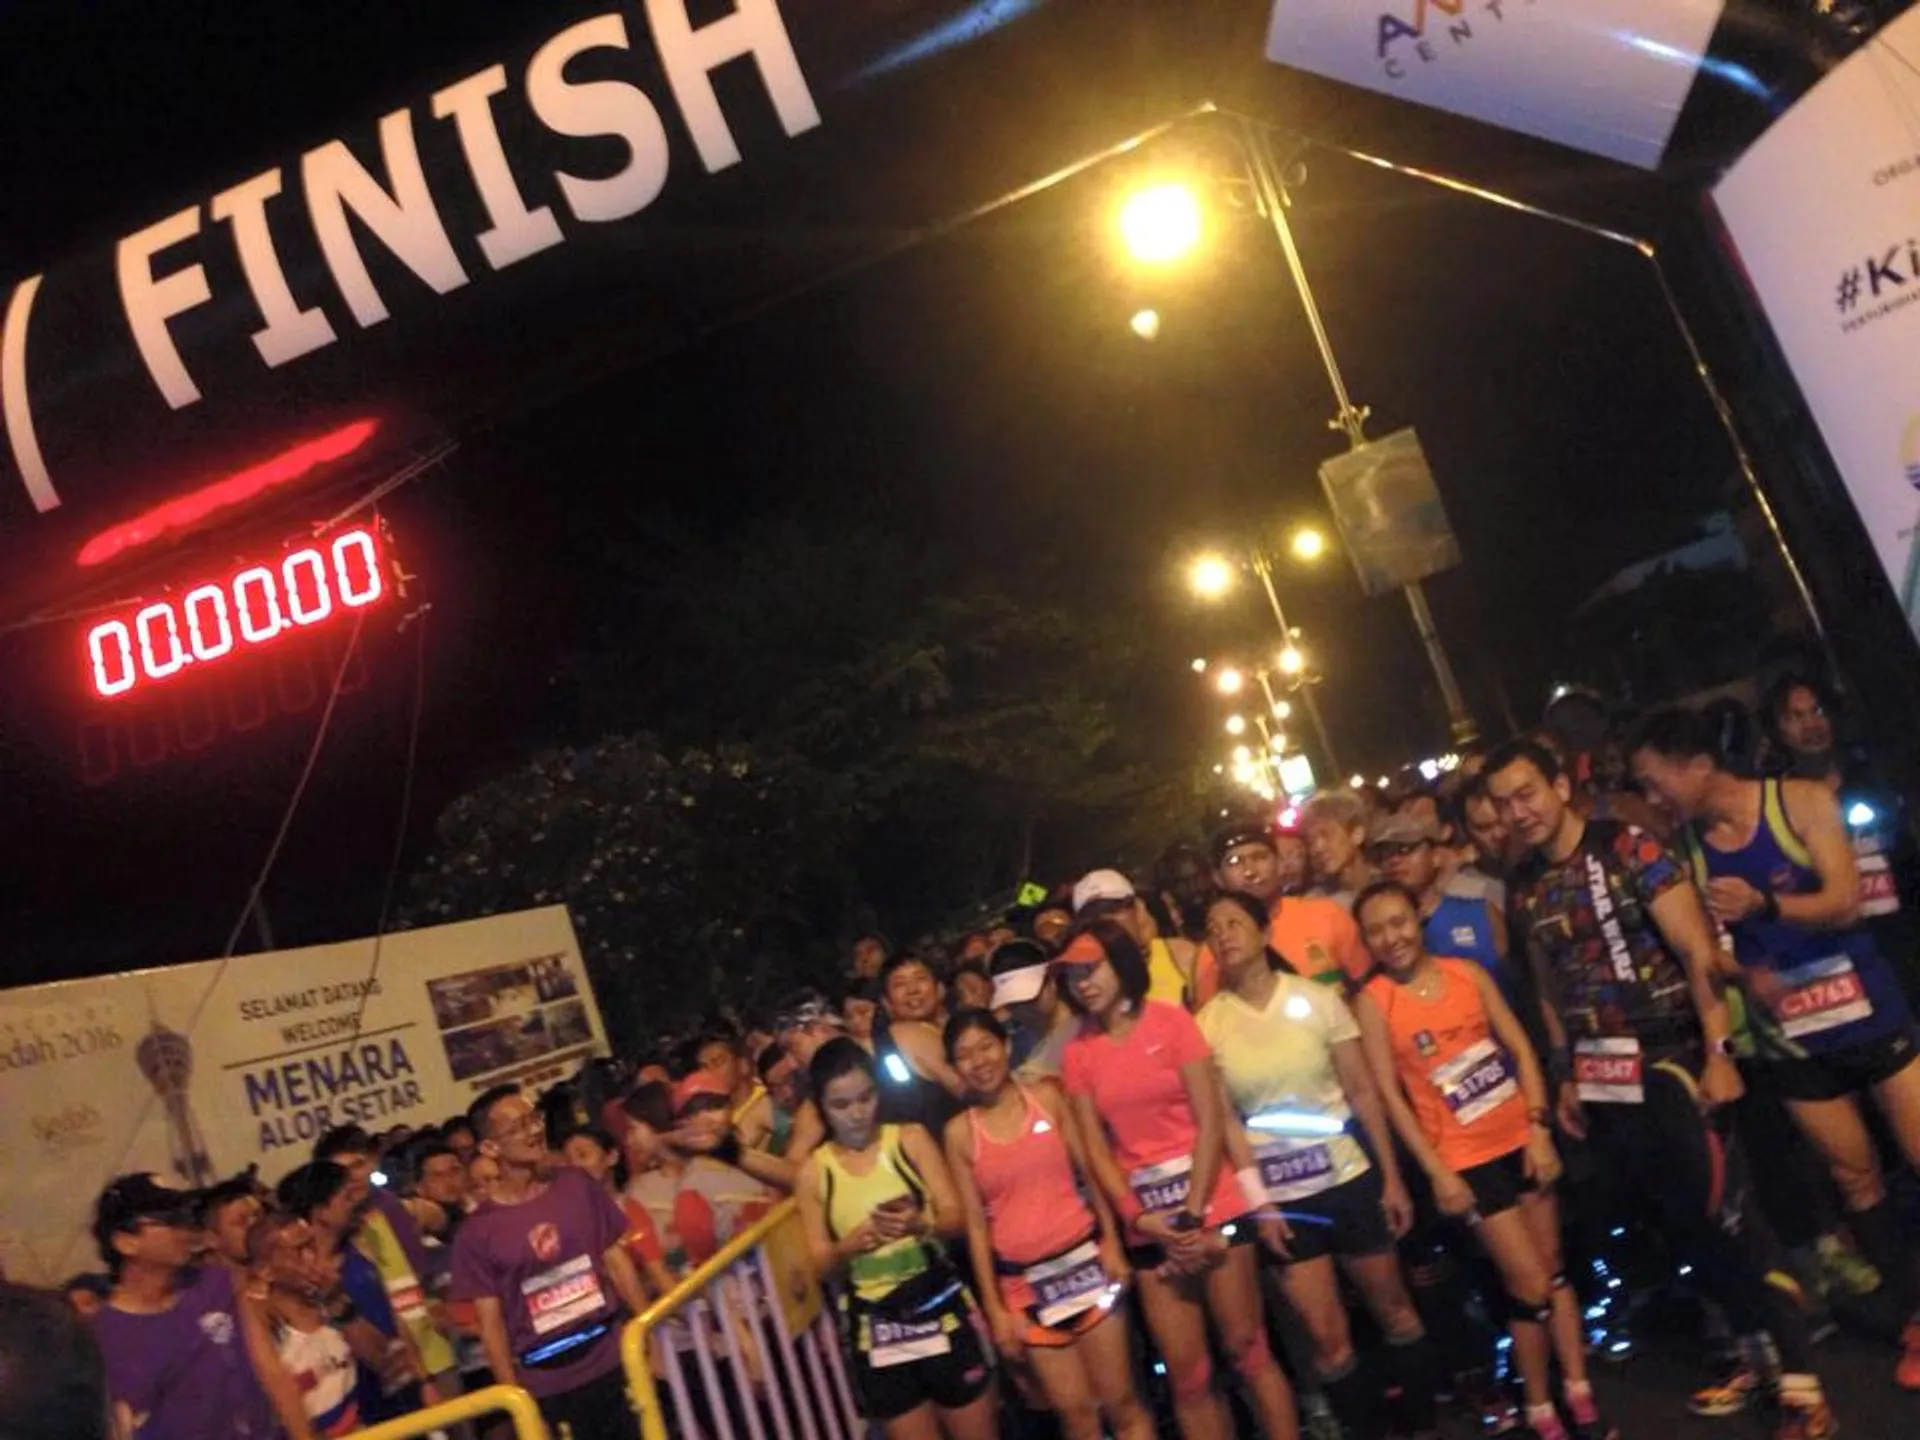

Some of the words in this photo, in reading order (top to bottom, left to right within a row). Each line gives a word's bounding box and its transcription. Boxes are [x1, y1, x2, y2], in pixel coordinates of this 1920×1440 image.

[115, 0, 822, 410] FINISH
[1585, 853, 1615, 922] STAR
[1602, 917, 1636, 983] WARS
[240, 989, 319, 1022] SELAMAT
[321, 977, 383, 1005] DATANG
[281, 1011, 362, 1044] WELCOME
[243, 1037, 416, 1118] MENARA
[258, 1104, 335, 1152] ALOR
[340, 1079, 425, 1123] SETAR
